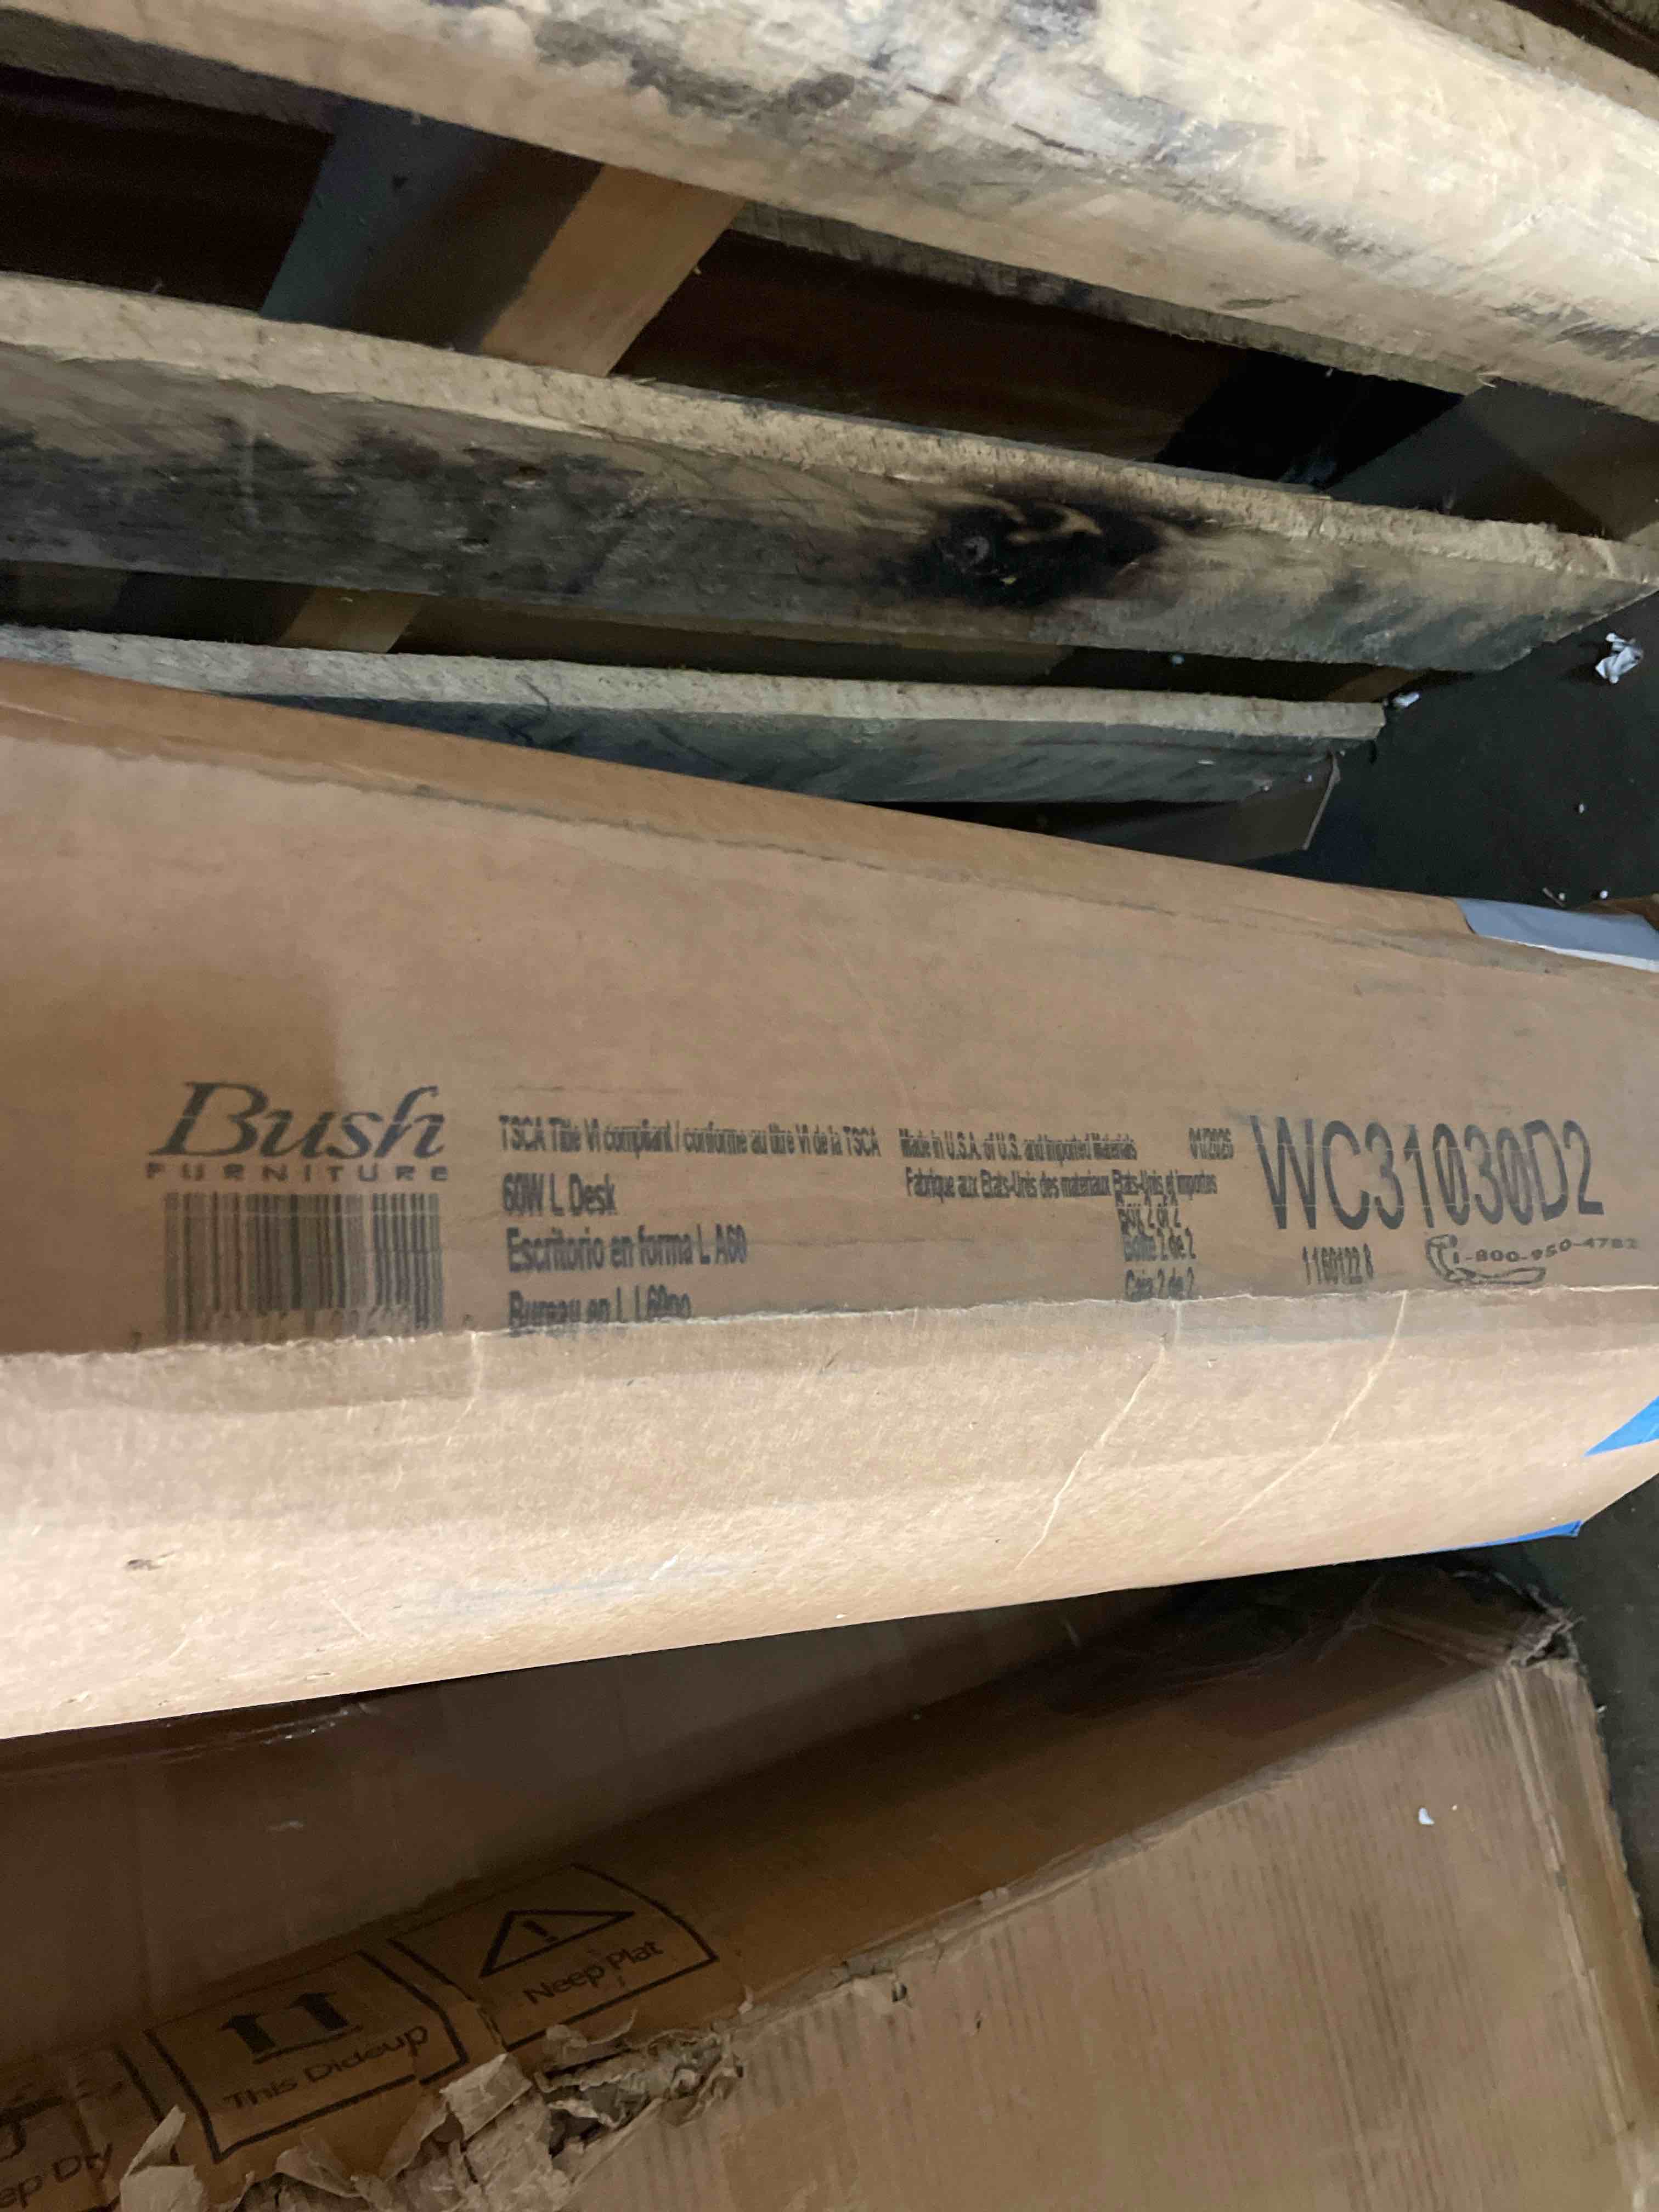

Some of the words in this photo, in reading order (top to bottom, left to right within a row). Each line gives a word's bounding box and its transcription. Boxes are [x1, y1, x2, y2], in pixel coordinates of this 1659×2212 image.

[149, 1081, 444, 1159] Bush
[499, 1114, 546, 1151] TSCA
[843, 1126, 881, 1158] TSCA
[146, 1162, 448, 1182] FURNITURE
[502, 1172, 544, 1216] 60W
[550, 1172, 565, 1216] L
[568, 1172, 617, 1216] Desk
[1250, 1114, 1605, 1231] WC31030D2
[506, 1227, 605, 1272] Escritorio
[610, 1236, 634, 1269] en
[637, 1224, 693, 1269] forma
[697, 1223, 712, 1264] L
[715, 1223, 747, 1265] A60
[1453, 1238, 1640, 1264] 1-800-950-4782
[0, 2175, 44, 2208] ep
